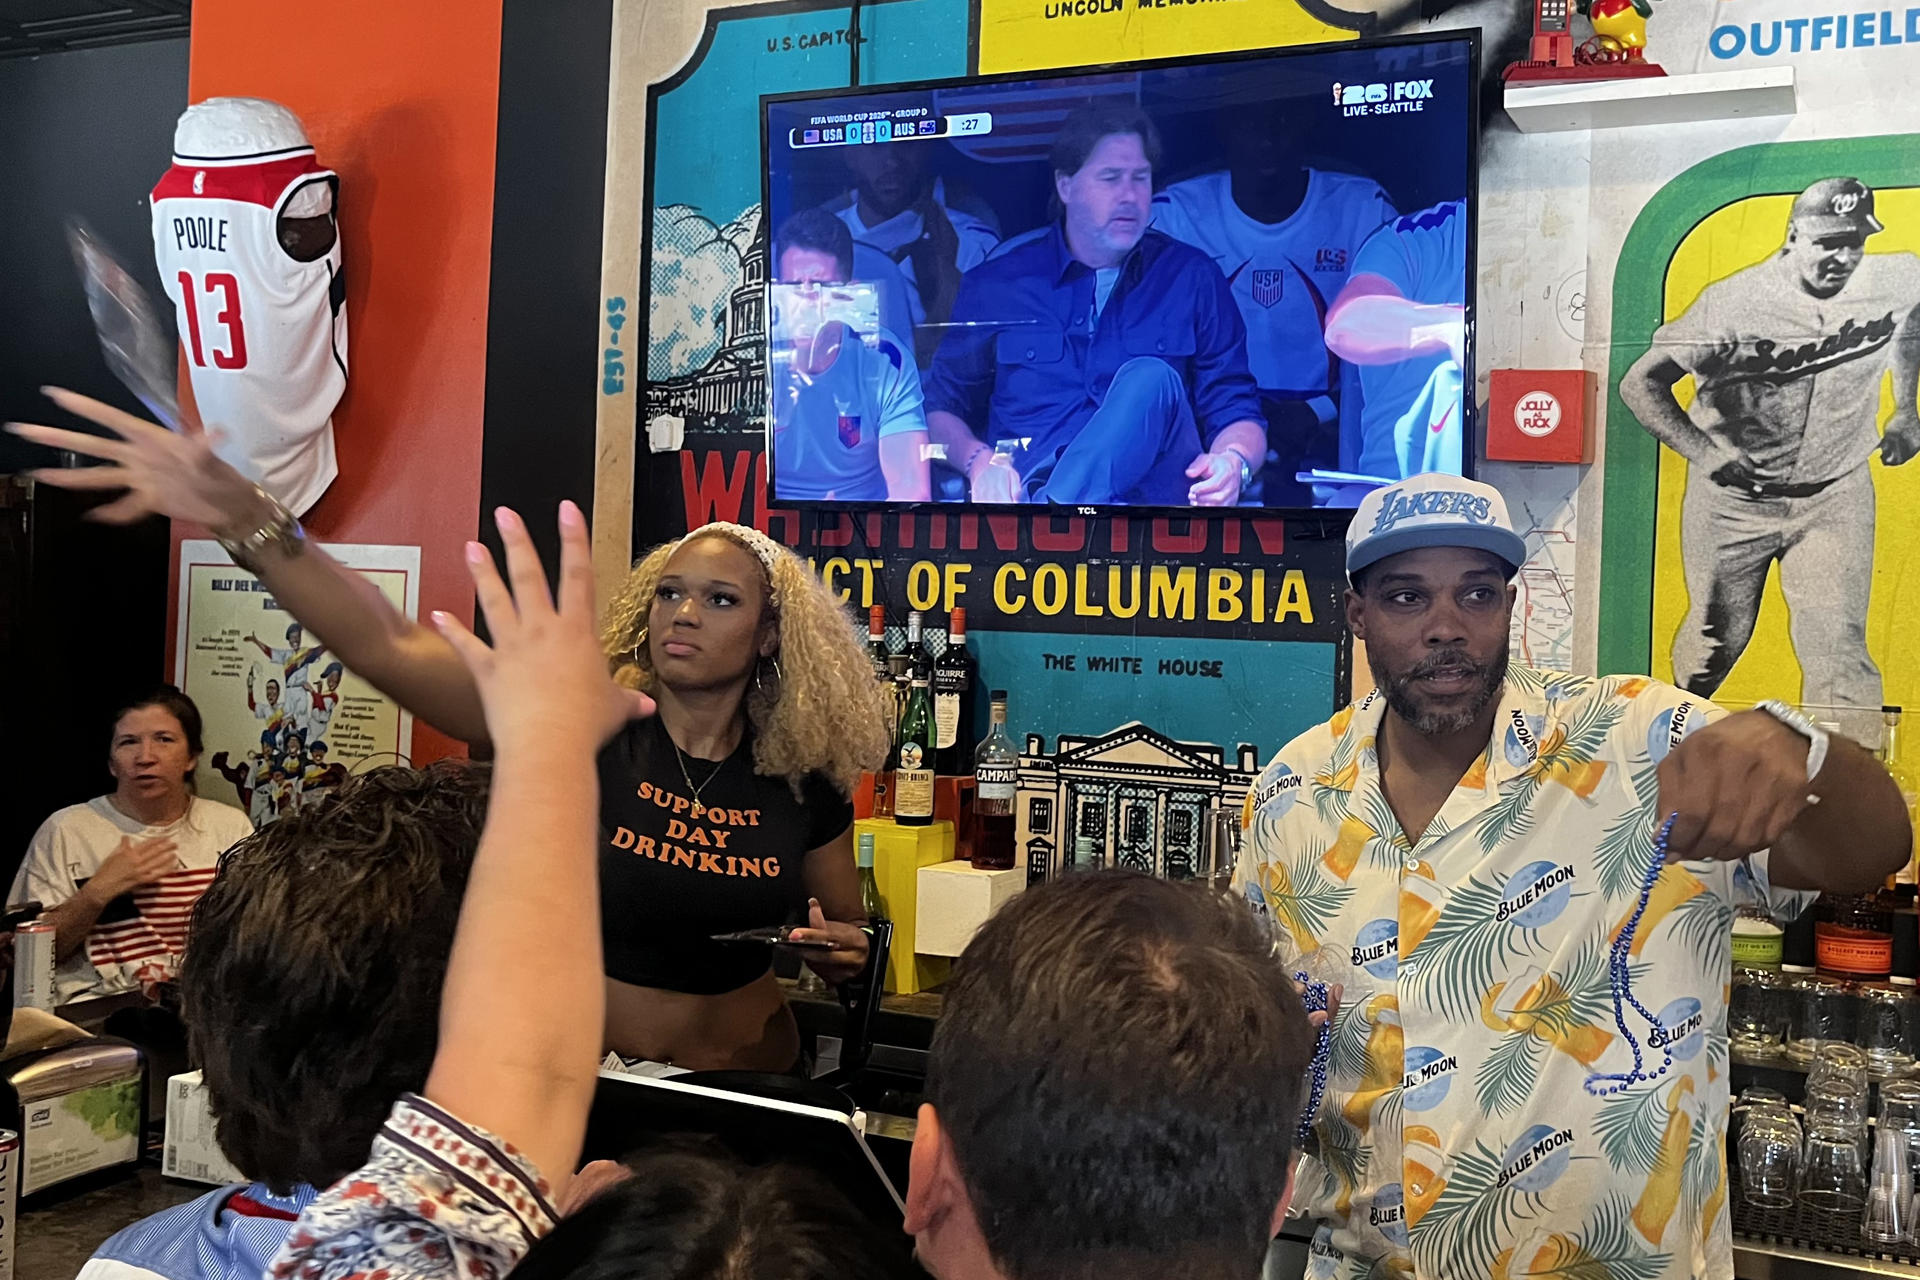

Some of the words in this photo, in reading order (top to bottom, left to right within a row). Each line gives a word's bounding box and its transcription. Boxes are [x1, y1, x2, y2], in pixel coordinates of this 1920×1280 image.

[1394, 79, 1434, 101] FOX
[811, 117, 826, 125] FIFA
[827, 114, 853, 123] WORLD
[853, 112, 868, 122] CUP
[895, 109, 920, 118] GROUP
[921, 108, 928, 116] D
[1343, 105, 1368, 117] LIVE
[1375, 101, 1424, 115] SEATTLE
[822, 128, 843, 142] USA
[850, 127, 858, 140] 0
[879, 125, 888, 137] 0
[893, 122, 916, 137] AUS
[173, 216, 228, 252] POOLE
[178, 271, 248, 370] 13
[1521, 400, 1553, 411] JOLLY
[1523, 418, 1551, 428] FUCK
[1078, 507, 1097, 515] TCL
[1369, 488, 1496, 534] LAKERS
[906, 559, 972, 612] OF
[993, 562, 1314, 624] COLUMBIA
[1042, 653, 1076, 671] THE
[1087, 656, 1143, 675] WHITE
[1158, 659, 1223, 679] HOUSE
[1510, 708, 1532, 747] MOON
[1670, 701, 1695, 734] MOON
[1275, 775, 1303, 794] MOON
[637, 782, 761, 826] SUPPORT
[666, 819, 731, 848] DAY
[611, 827, 780, 878] DRINKING
[1496, 889, 1533, 922] BLUE
[1534, 865, 1576, 898] MOON
[1351, 942, 1384, 966] BLUE
[1421, 1056, 1458, 1080] MOON
[1497, 1155, 1533, 1188] BLUE
[1534, 1129, 1575, 1161] MOON
[1369, 1205, 1398, 1226] BLUE
